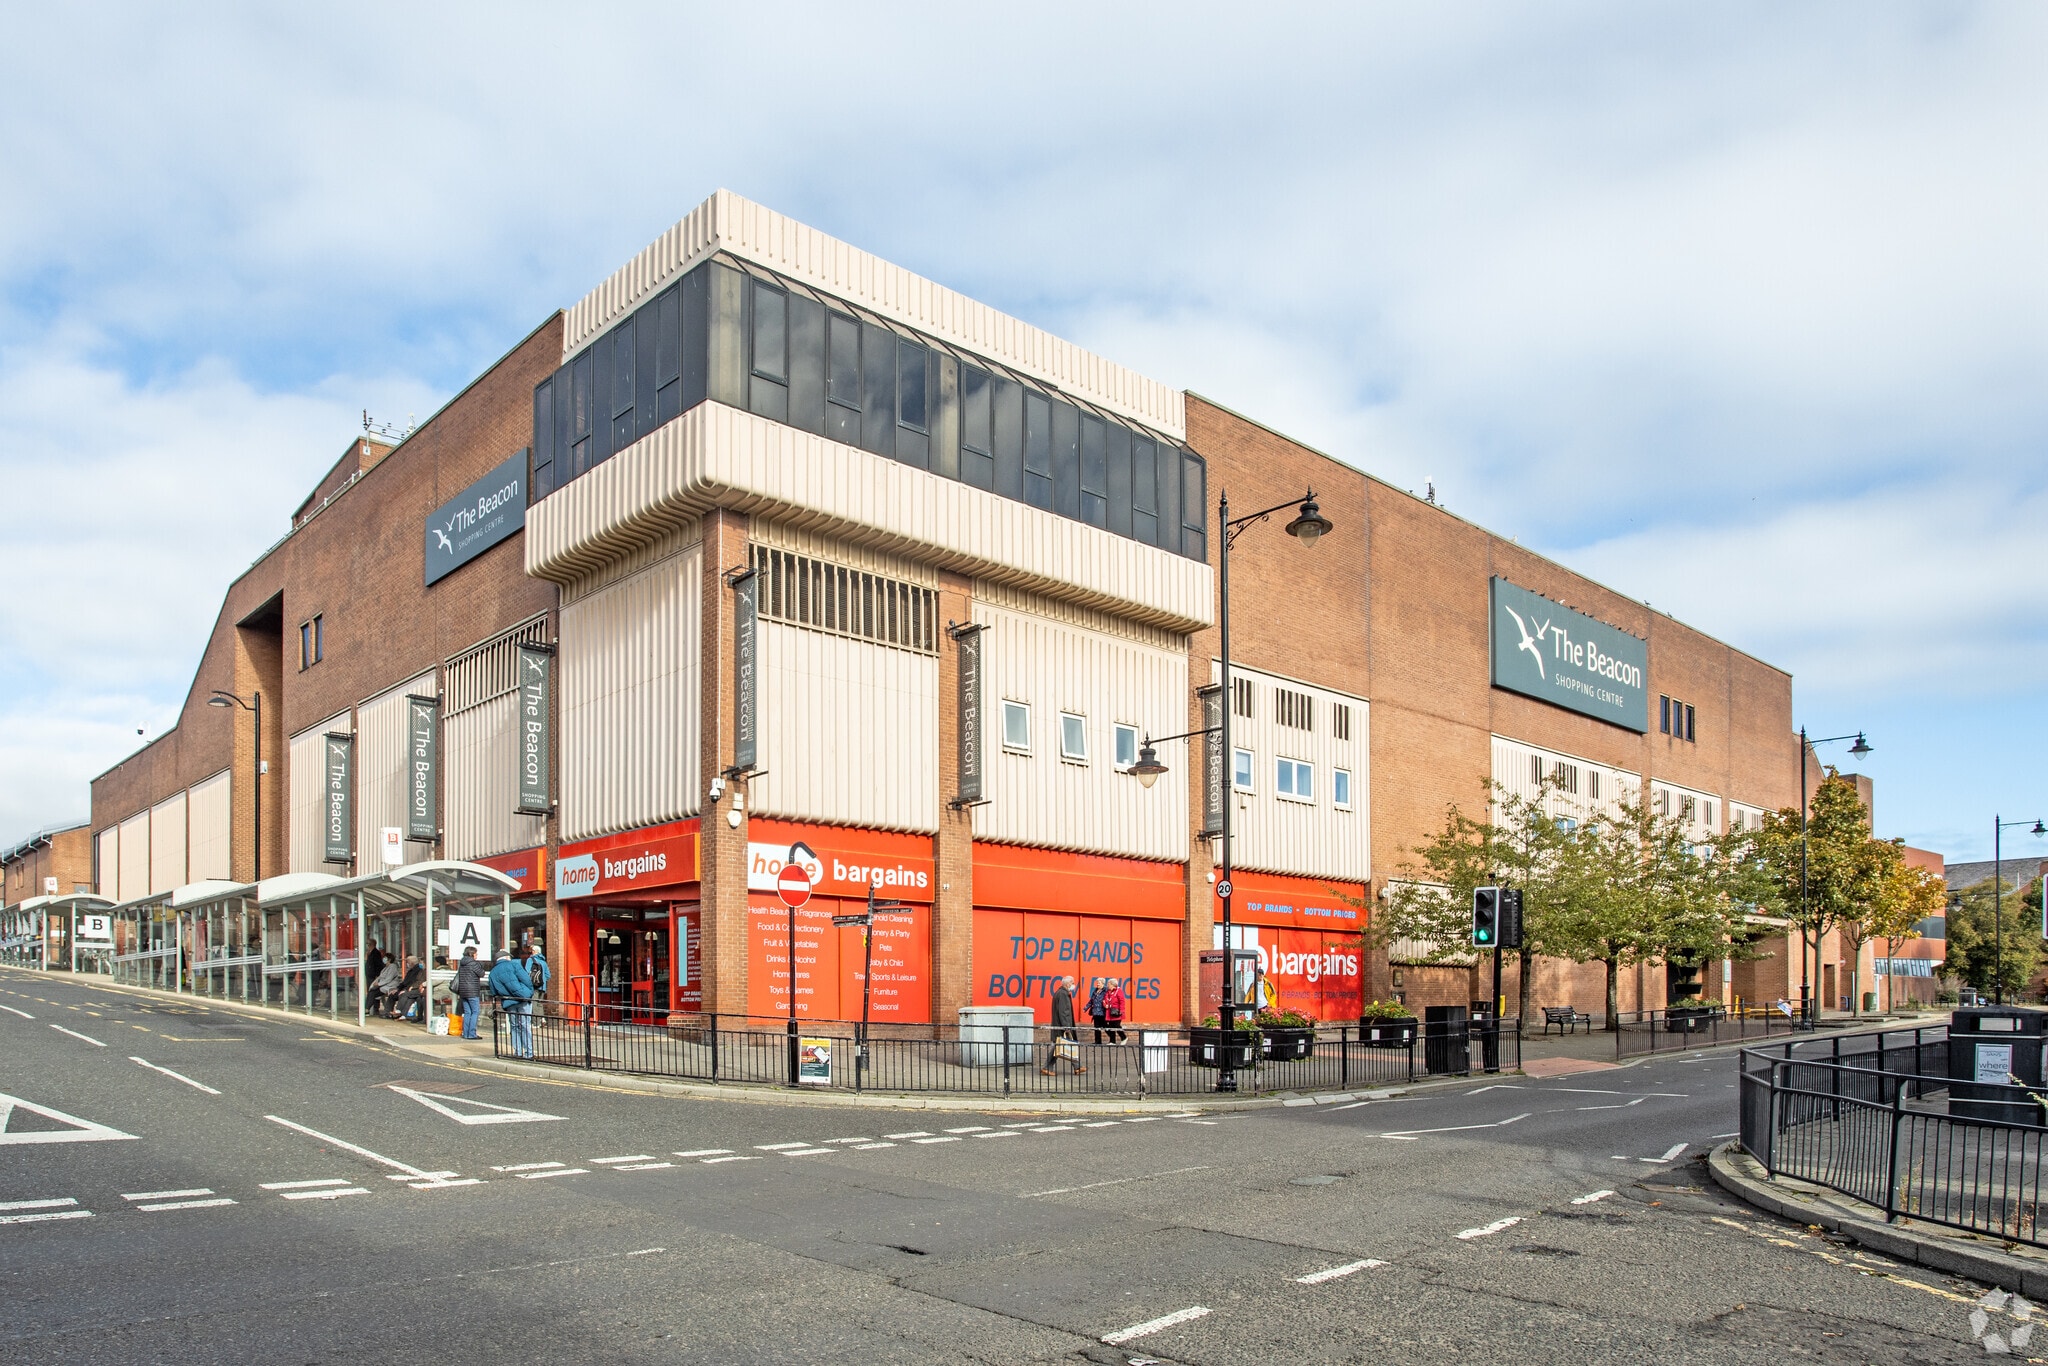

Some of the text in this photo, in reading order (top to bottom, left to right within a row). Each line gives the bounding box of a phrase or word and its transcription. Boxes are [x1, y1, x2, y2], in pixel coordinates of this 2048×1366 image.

[456, 480, 518, 532] The Beacon
[458, 514, 504, 550] SHOPPING CENTRE
[741, 619, 752, 658] The
[1550, 626, 1640, 688] The Beacon
[1555, 674, 1624, 708] SHOPPING CENTRE
[740, 665, 751, 741] Beacon
[965, 665, 976, 775] The Beacon
[526, 682, 543, 785] The Beacon
[416, 728, 431, 816] The Beacon
[1210, 755, 1220, 812] Beacon
[332, 764, 346, 841] The Beacon
[522, 792, 546, 800] SHOPPING
[562, 851, 666, 886] home bargains
[753, 852, 928, 888] hoe bargains
[1219, 885, 1230, 894] 20
[748, 906, 768, 914] Health
[799, 909, 832, 918] Fragrances
[889, 914, 913, 924] Cleaning
[1247, 902, 1262, 910] TOP
[1265, 904, 1293, 914] BRANDS
[1304, 908, 1331, 916] BOTTOM
[1334, 910, 1356, 918] PRICES
[92, 919, 103, 930] B
[460, 922, 480, 944] A
[758, 922, 774, 931] Food
[782, 924, 824, 934] Cofectionery
[896, 930, 910, 938] Party
[784, 940, 818, 949] Vgetables
[879, 944, 892, 952] Pets
[1010, 936, 1144, 964] TOP BRANDS
[766, 954, 786, 962] Drinks
[1272, 944, 1358, 982] bargains
[872, 973, 890, 982] Sports
[770, 986, 784, 994] Toys
[874, 988, 898, 996] Furniture
[873, 1002, 898, 1010] Seasonal
[1979, 1061, 2008, 1070] where
